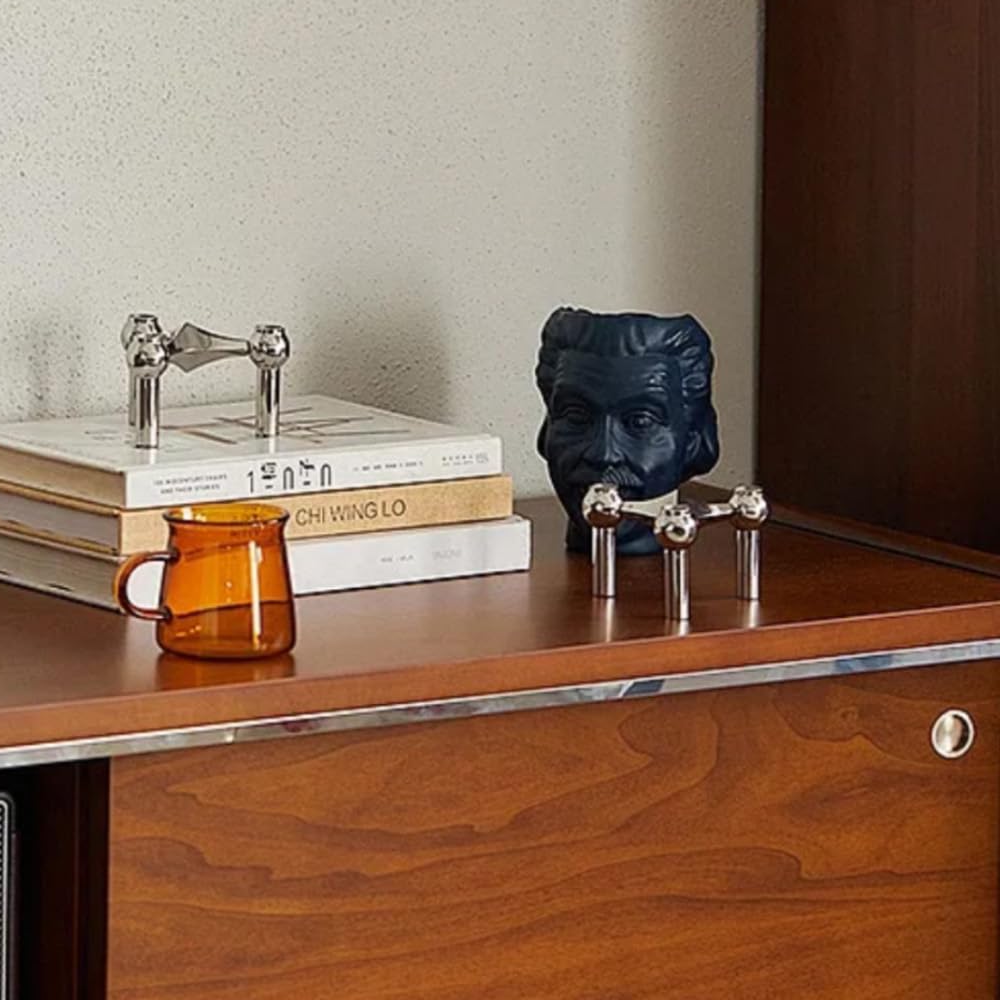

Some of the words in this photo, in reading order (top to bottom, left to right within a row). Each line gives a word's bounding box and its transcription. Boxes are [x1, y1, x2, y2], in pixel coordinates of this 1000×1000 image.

[295, 508, 326, 527] CHI
[330, 501, 379, 522] WING
[381, 499, 407, 518] LO
